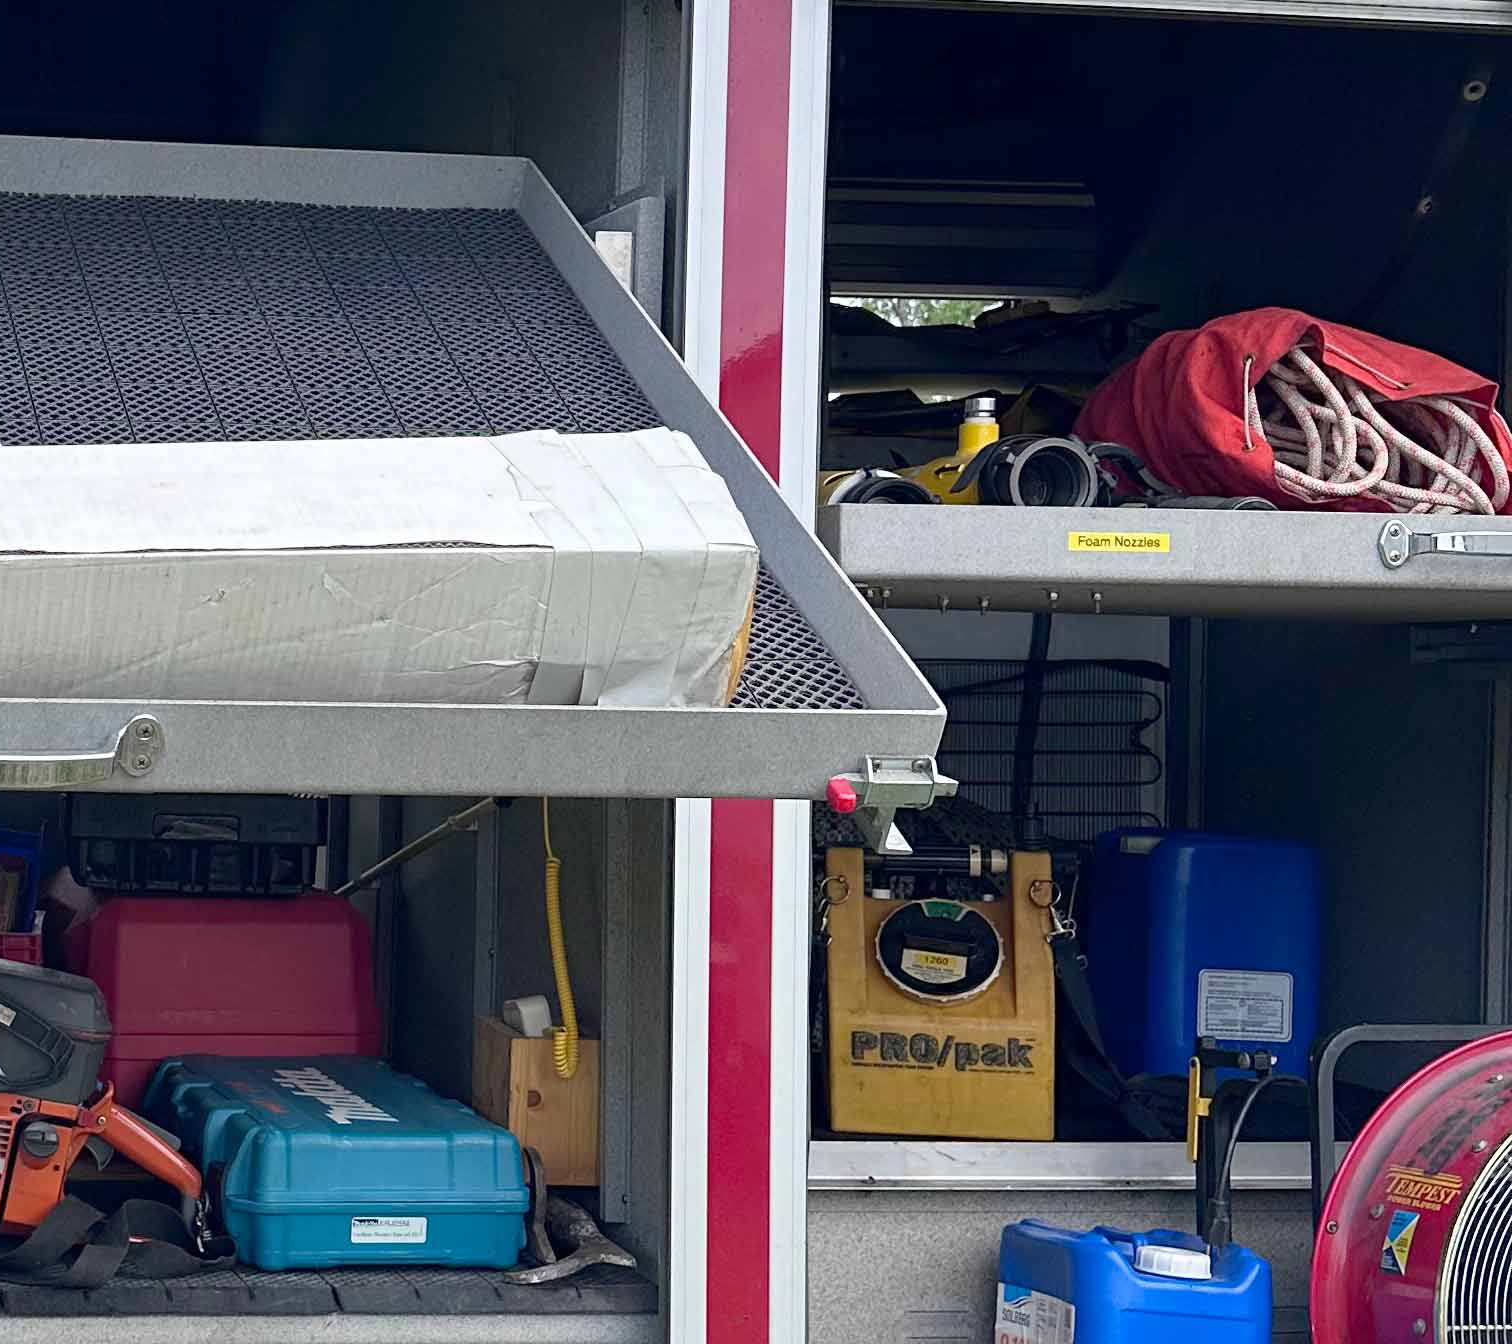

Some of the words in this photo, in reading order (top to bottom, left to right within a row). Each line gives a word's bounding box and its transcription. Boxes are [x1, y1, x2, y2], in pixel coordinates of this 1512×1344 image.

[1078, 535, 1111, 547] Foam
[1114, 536, 1160, 548] Nozzles
[851, 1031, 1034, 1072] PRO/pak
[1386, 1175, 1462, 1204] TEMPEST
